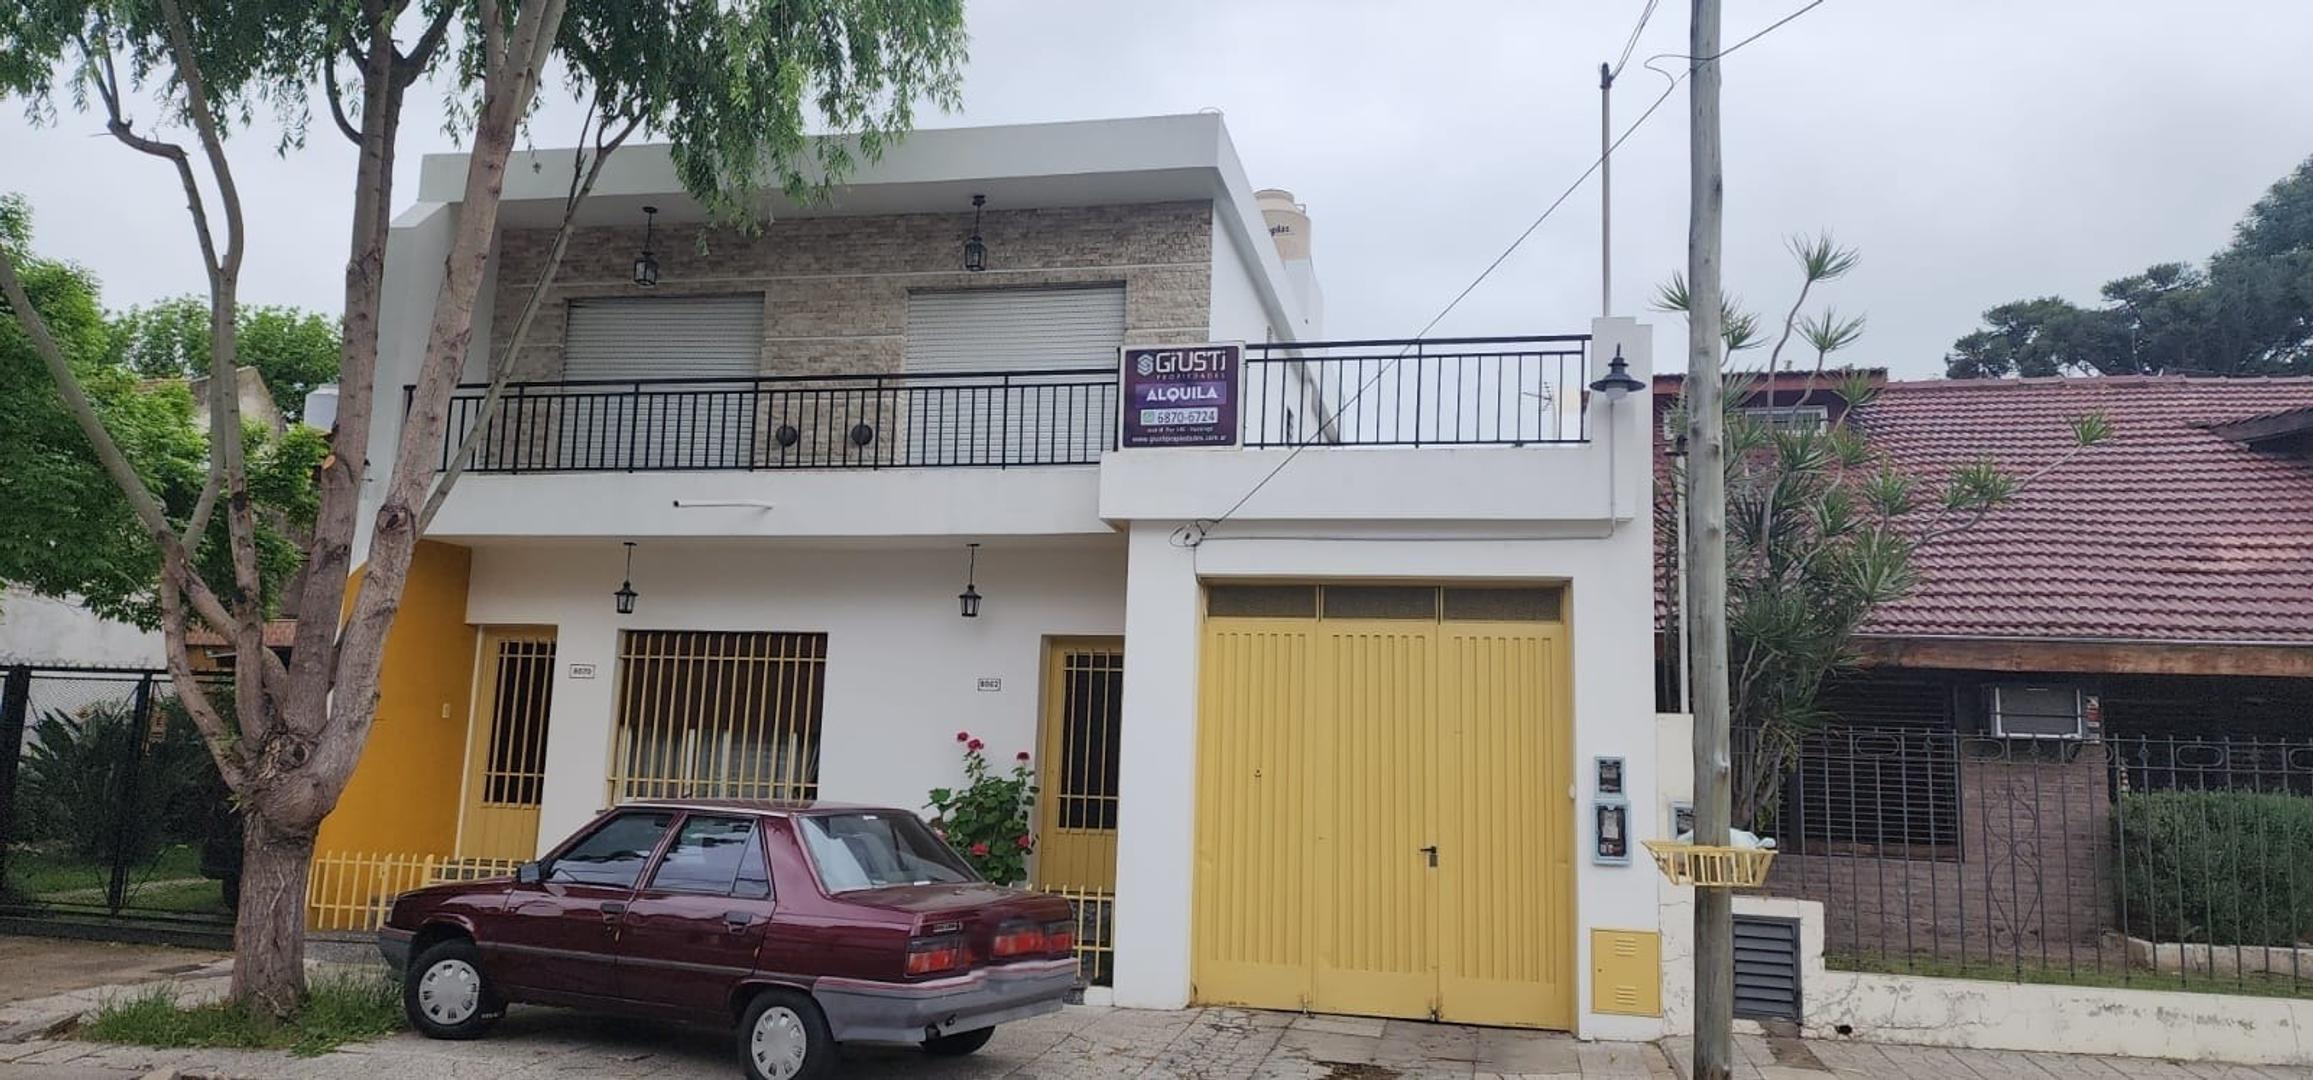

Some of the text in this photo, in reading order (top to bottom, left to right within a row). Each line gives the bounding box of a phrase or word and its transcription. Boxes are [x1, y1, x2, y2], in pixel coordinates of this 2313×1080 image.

[1157, 372, 1225, 380] PROPIEDADES
[1146, 386, 1218, 402] ALQUILA
[1157, 410, 1216, 424] 6870-6724
